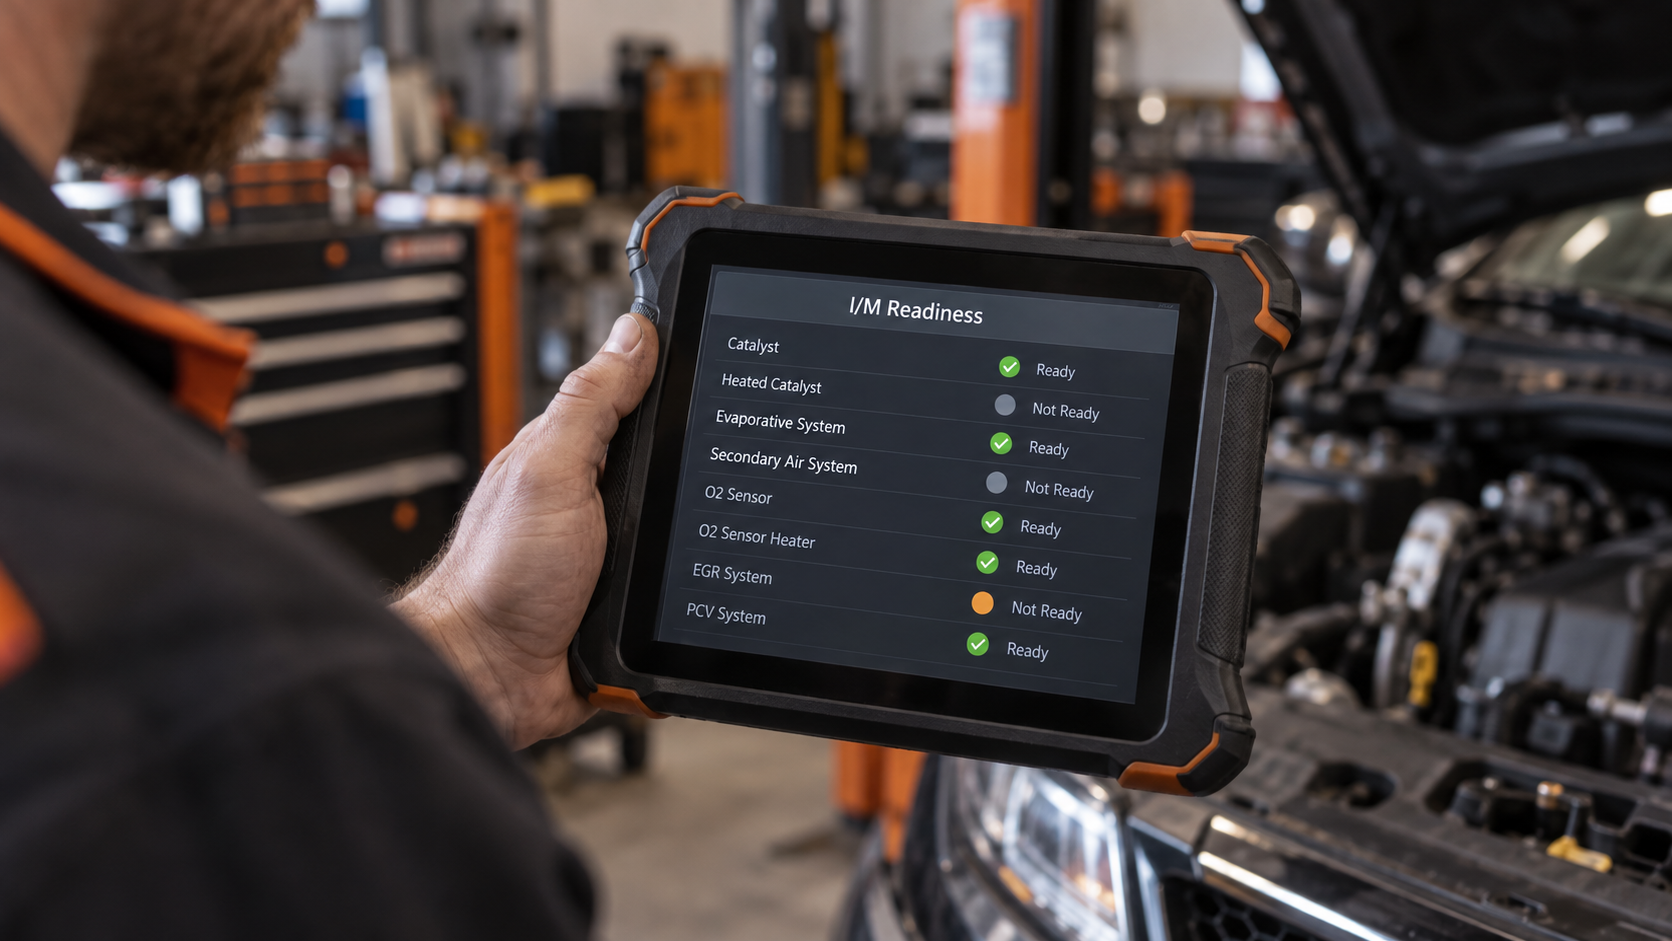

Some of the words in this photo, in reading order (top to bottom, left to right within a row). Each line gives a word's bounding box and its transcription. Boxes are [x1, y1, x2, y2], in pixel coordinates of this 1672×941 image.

[849, 295, 882, 316] I/M
[886, 299, 984, 325] Readiness
[727, 336, 780, 356] Catalyst
[1036, 362, 1076, 382] Ready
[721, 372, 769, 390] Heated
[770, 377, 823, 397] Catalyst
[715, 409, 794, 430] Evaporative
[796, 416, 846, 435] System
[1032, 401, 1057, 417] Not
[1059, 404, 1101, 424] Ready
[709, 446, 782, 471] Secondary
[783, 454, 806, 470] Air
[807, 456, 858, 475] System
[1029, 440, 1070, 460] Ready
[704, 485, 724, 500] O2
[726, 487, 774, 505] Sensor
[1024, 479, 1051, 496] Not
[1053, 482, 1095, 503] Ready
[698, 523, 718, 539] O2
[720, 525, 768, 544] Sensor
[769, 531, 817, 550] Heater
[1020, 519, 1062, 540] Ready
[692, 562, 721, 579] EGR
[723, 566, 773, 585] System
[1016, 559, 1058, 581] Ready
[686, 602, 716, 619] PCV
[716, 606, 767, 626] System
[1011, 600, 1037, 617] Not
[1040, 603, 1083, 625] Ready
[1006, 641, 1050, 663] Ready
